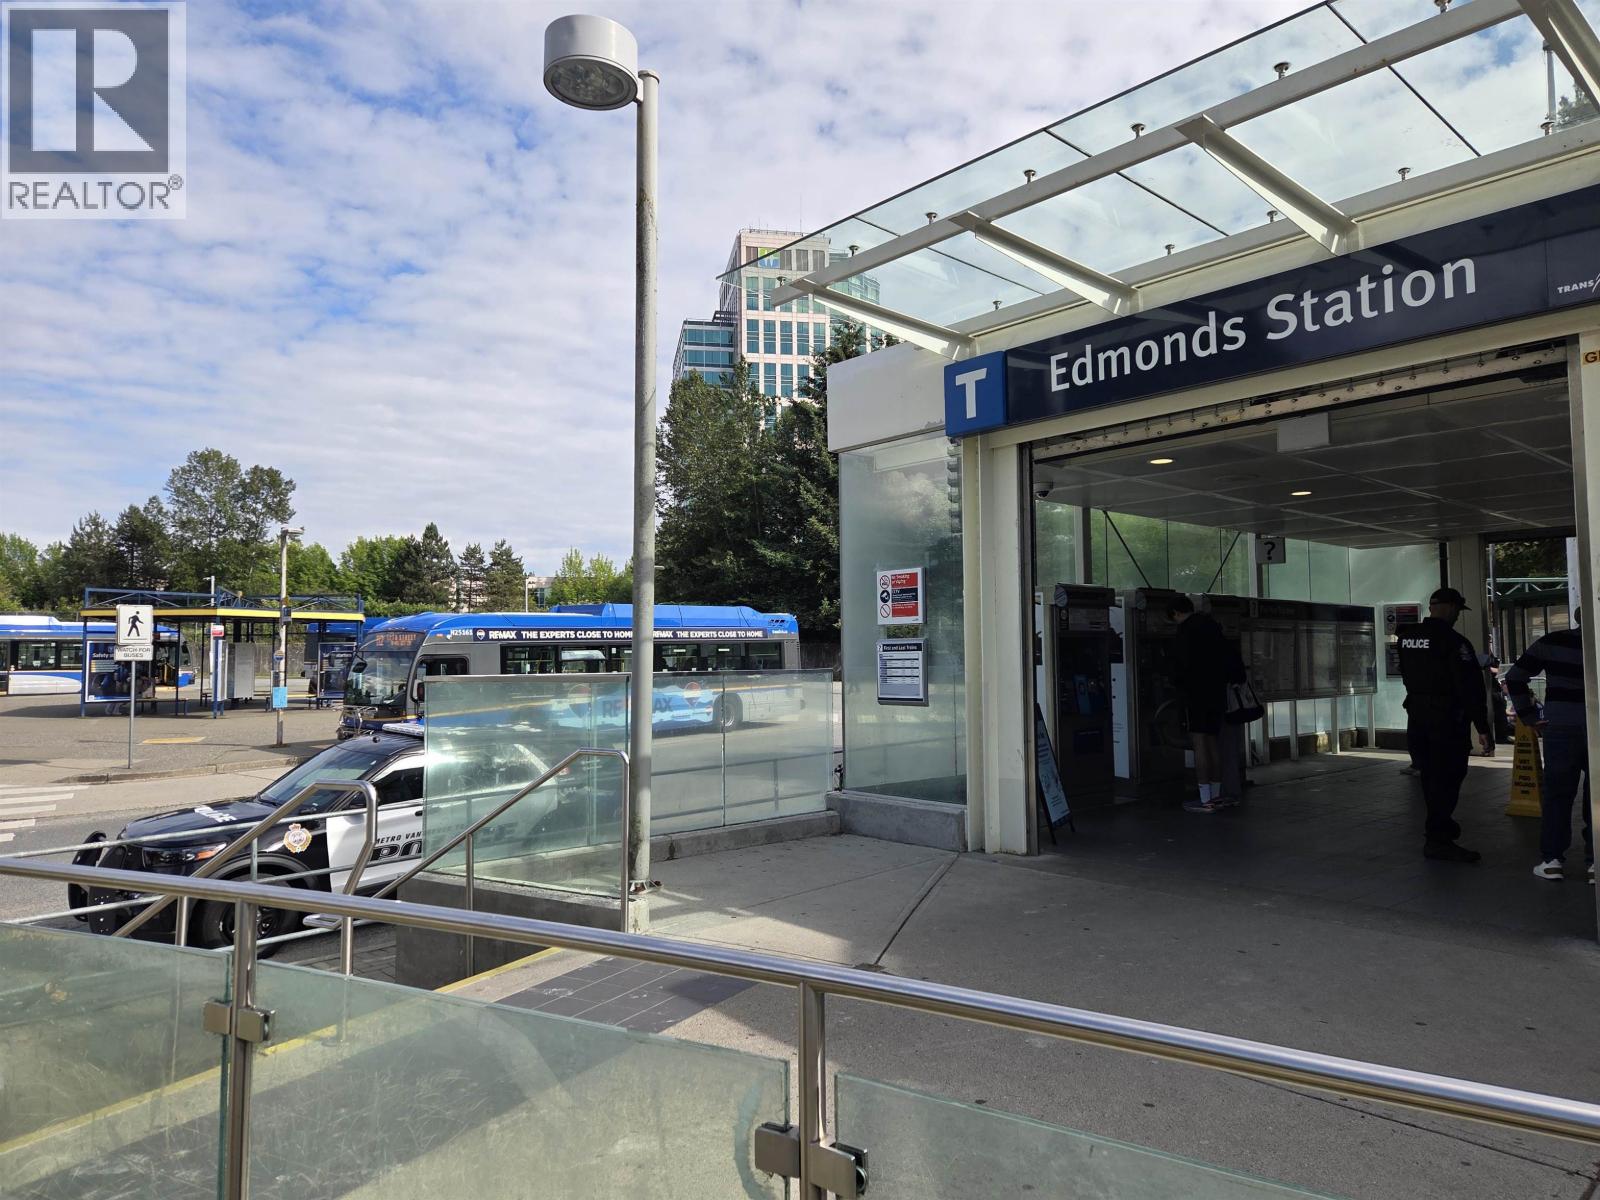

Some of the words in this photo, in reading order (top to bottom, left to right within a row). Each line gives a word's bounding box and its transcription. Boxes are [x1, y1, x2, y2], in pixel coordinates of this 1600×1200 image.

[1050, 310, 1247, 393] Edmonds
[1266, 256, 1477, 341] Station
[1584, 351, 1600, 364] G
[955, 367, 988, 420] T
[521, 630, 538, 639] THE
[539, 630, 575, 639] EXPERTS
[576, 630, 601, 639] CLOSE
[602, 630, 613, 638] TO
[614, 630, 633, 639] HOM
[676, 630, 690, 638] THE
[690, 630, 717, 638] EXPERTS
[718, 630, 736, 638] CLOSE
[1401, 639, 1430, 649] POLICE
